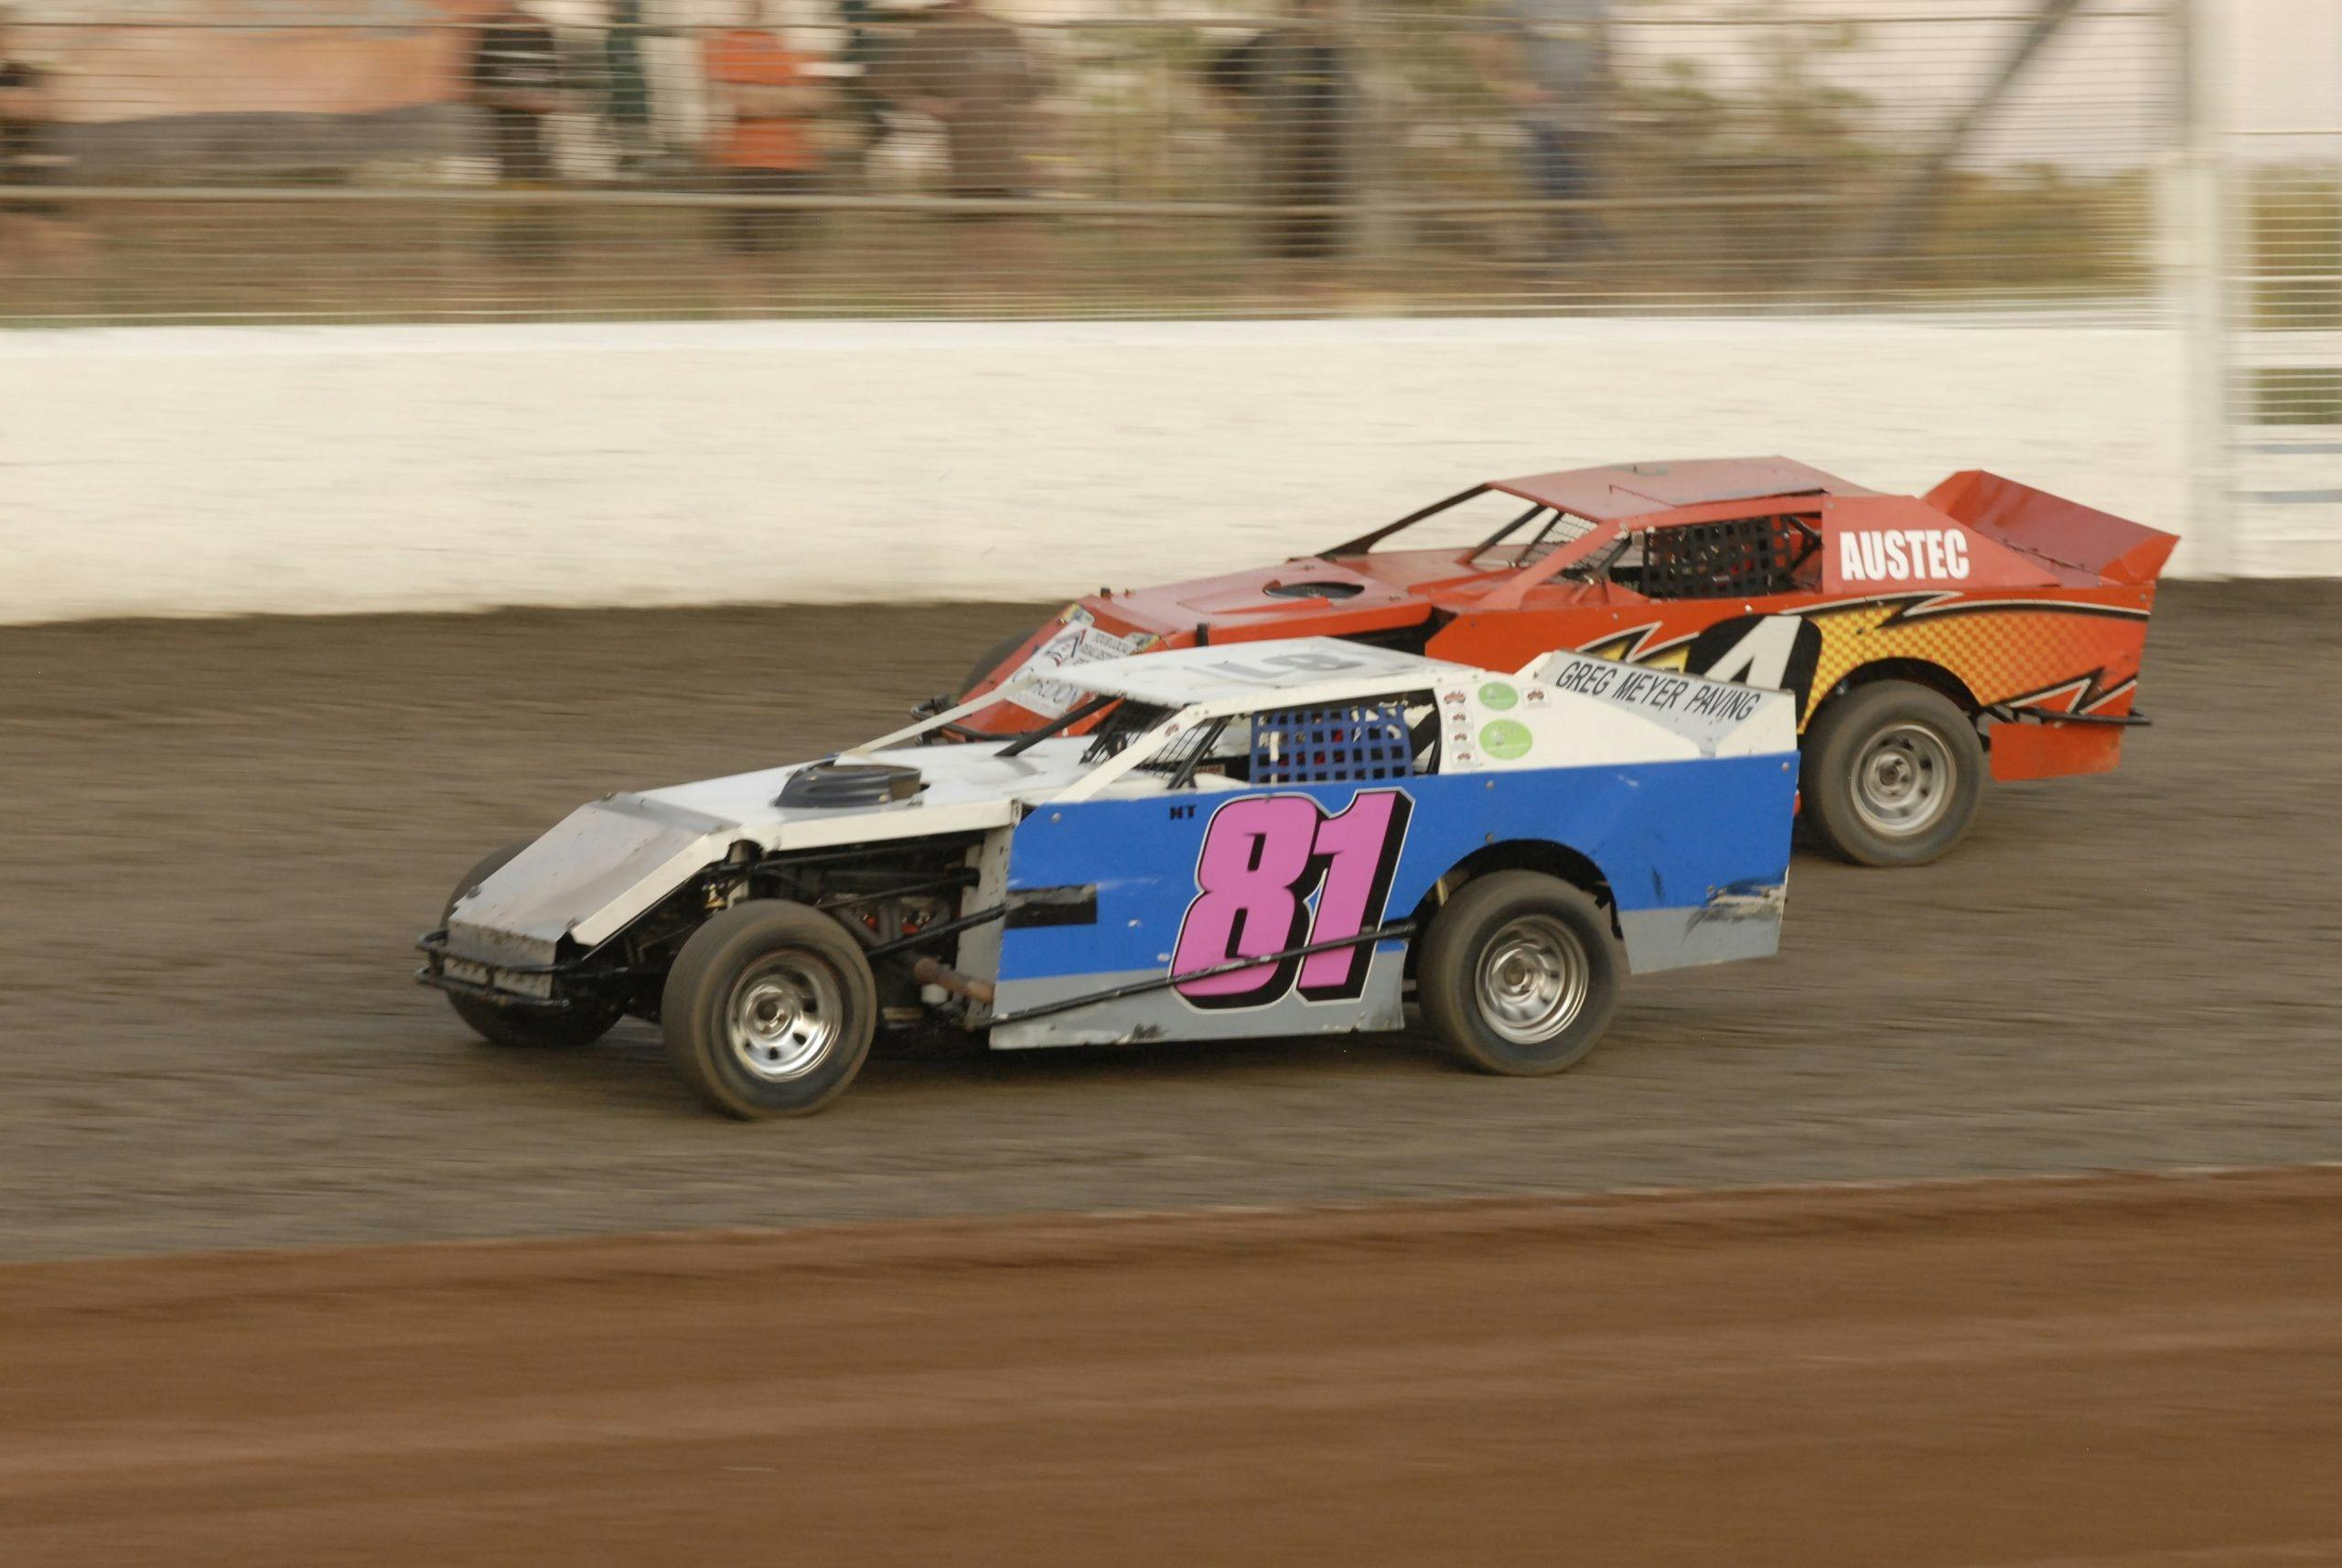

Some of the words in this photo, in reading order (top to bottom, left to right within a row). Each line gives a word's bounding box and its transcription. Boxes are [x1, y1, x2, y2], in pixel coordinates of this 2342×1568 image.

[1839, 528, 1971, 581] AUSTEC
[1555, 660, 1617, 696] GREG
[1611, 671, 1690, 711] MEYER
[1682, 685, 1761, 721] PAVING
[1170, 787, 1415, 1015] 81
